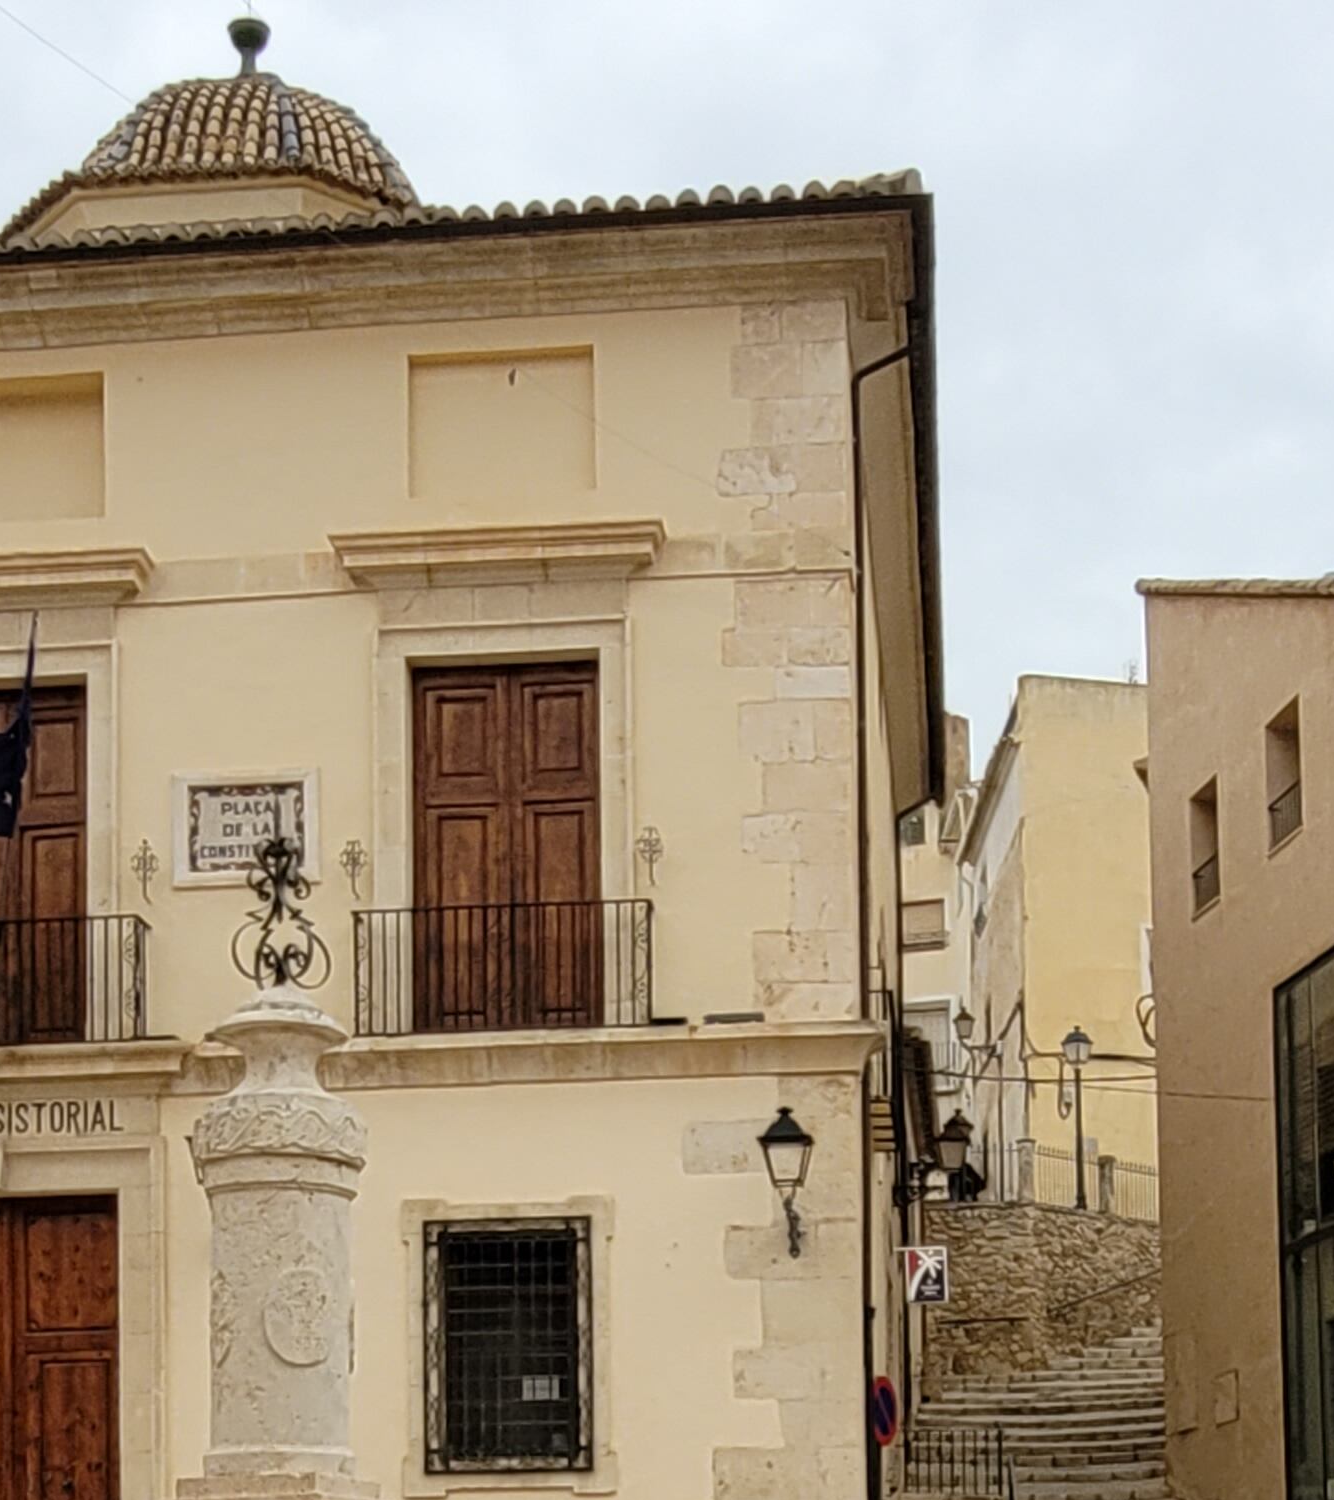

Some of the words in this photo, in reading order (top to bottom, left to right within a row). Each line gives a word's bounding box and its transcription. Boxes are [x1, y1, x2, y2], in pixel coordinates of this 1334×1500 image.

[220, 800, 274, 817] PLAÇA
[222, 822, 243, 838] DE
[252, 821, 271, 836] LA
